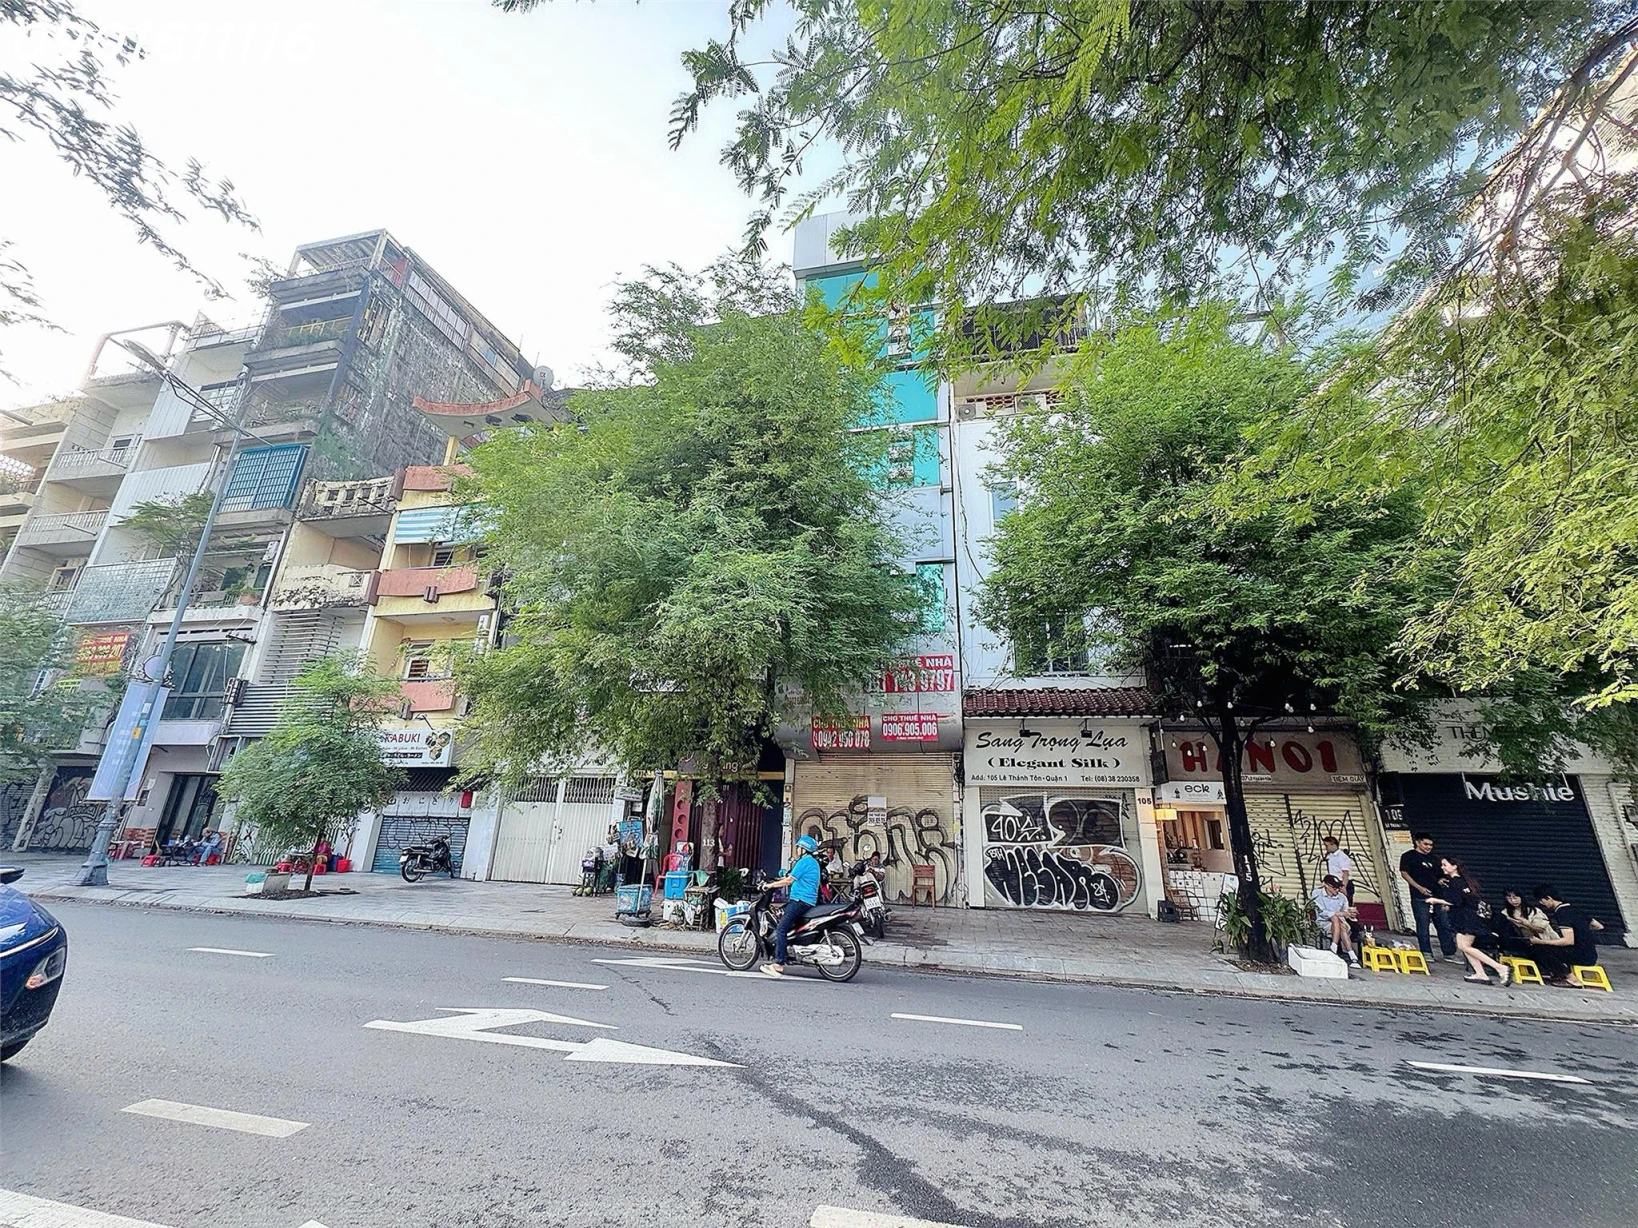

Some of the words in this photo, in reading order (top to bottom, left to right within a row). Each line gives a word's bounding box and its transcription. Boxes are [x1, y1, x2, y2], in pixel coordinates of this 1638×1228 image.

[926, 657, 953, 667] NHÀ
[900, 714, 919, 722] THUÊ
[883, 722, 938, 736] 0906.905.006
[976, 731, 1025, 753] Sang
[1028, 732, 1082, 753] Trọng
[1085, 730, 1128, 751] Lụa
[987, 774, 998, 782] 105
[1137, 797, 1152, 805] 105
[1384, 808, 1404, 821] 109
[702, 839, 716, 847] 113
